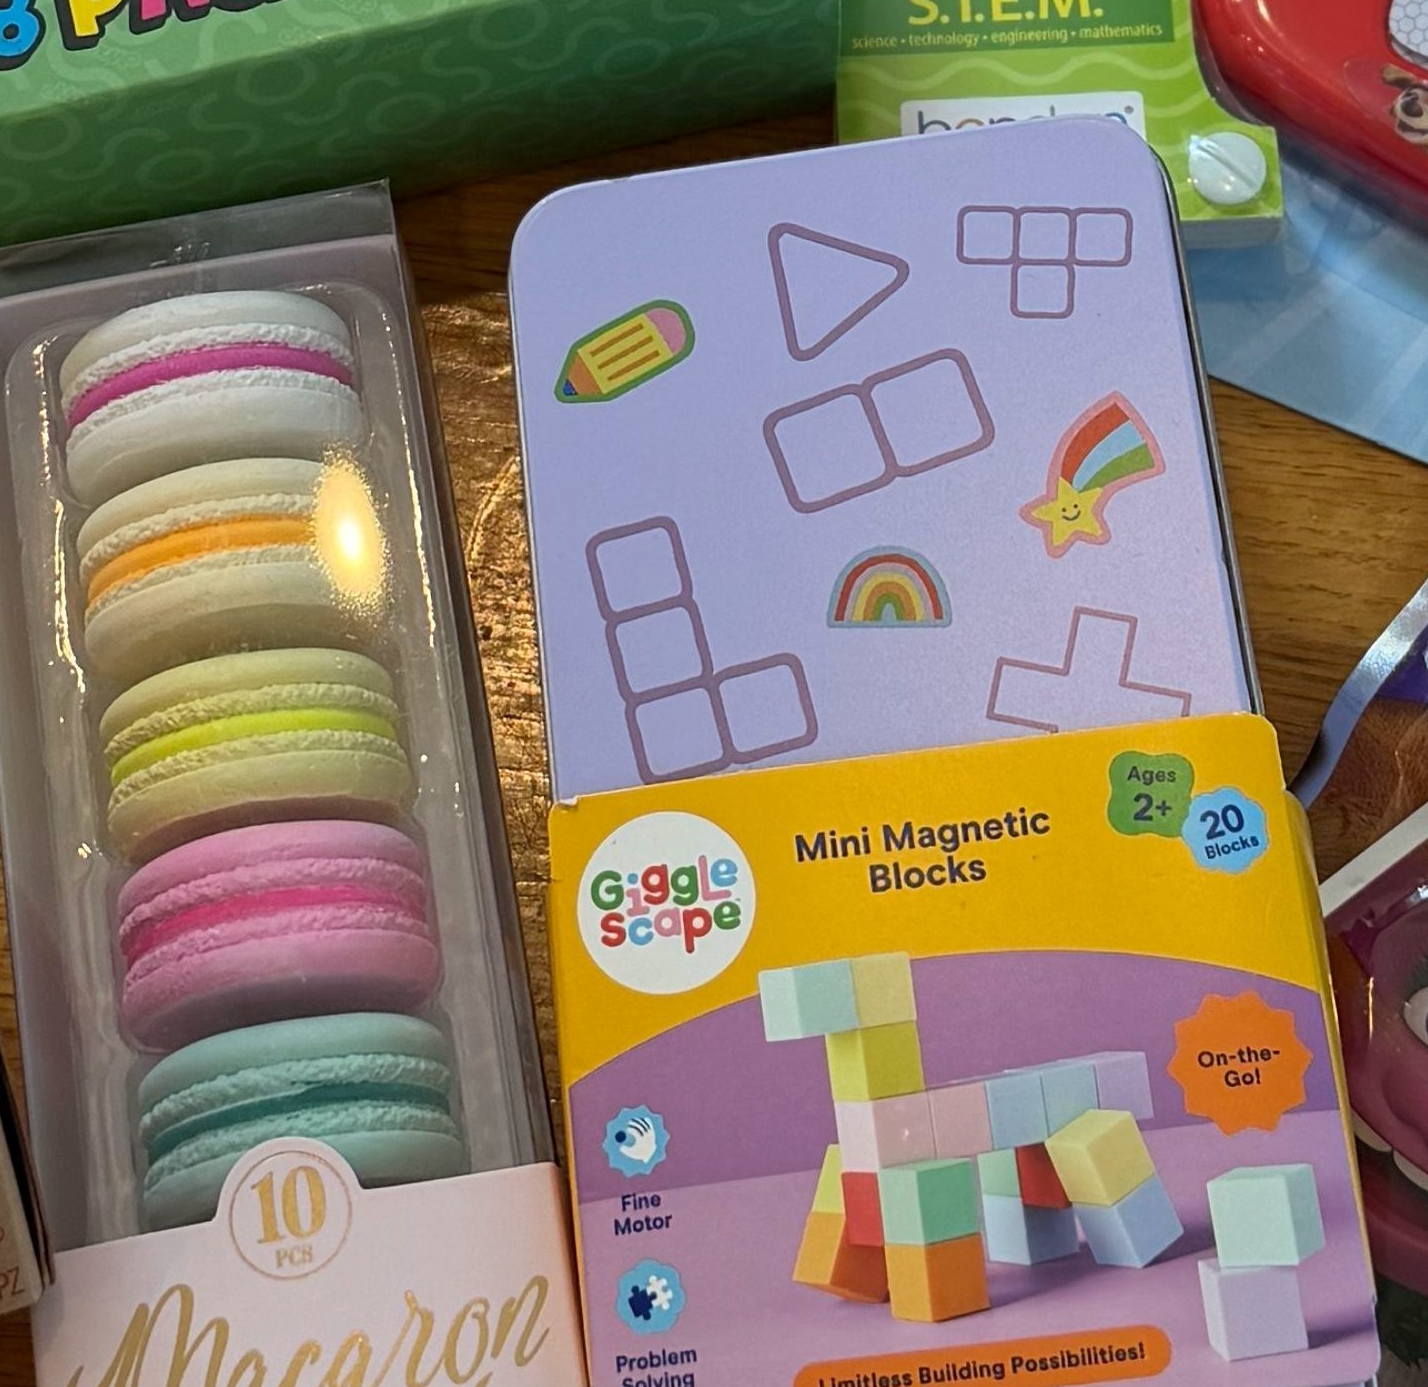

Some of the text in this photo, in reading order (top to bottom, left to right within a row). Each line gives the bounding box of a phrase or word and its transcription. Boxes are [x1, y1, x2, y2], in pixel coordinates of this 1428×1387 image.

[851, 22, 1163, 50] science technology engineering mathematics
[1126, 765, 1178, 787] Ages
[1132, 792, 1173, 822] 2+
[795, 806, 1051, 863] Mini Magnetic
[1199, 804, 1246, 842] 20
[1204, 834, 1261, 861] Blocks
[869, 855, 988, 895] Blocks
[1197, 1045, 1282, 1070] On-the-
[1223, 1069, 1263, 1088] Go!
[249, 1163, 329, 1246] 10
[620, 1191, 662, 1213] Fine
[612, 1212, 674, 1237] Motor
[274, 1245, 314, 1268] PCS
[615, 1345, 698, 1375] Problem
[918, 1357, 1006, 1387] Building
[1009, 1342, 1147, 1377] Possibilities!
